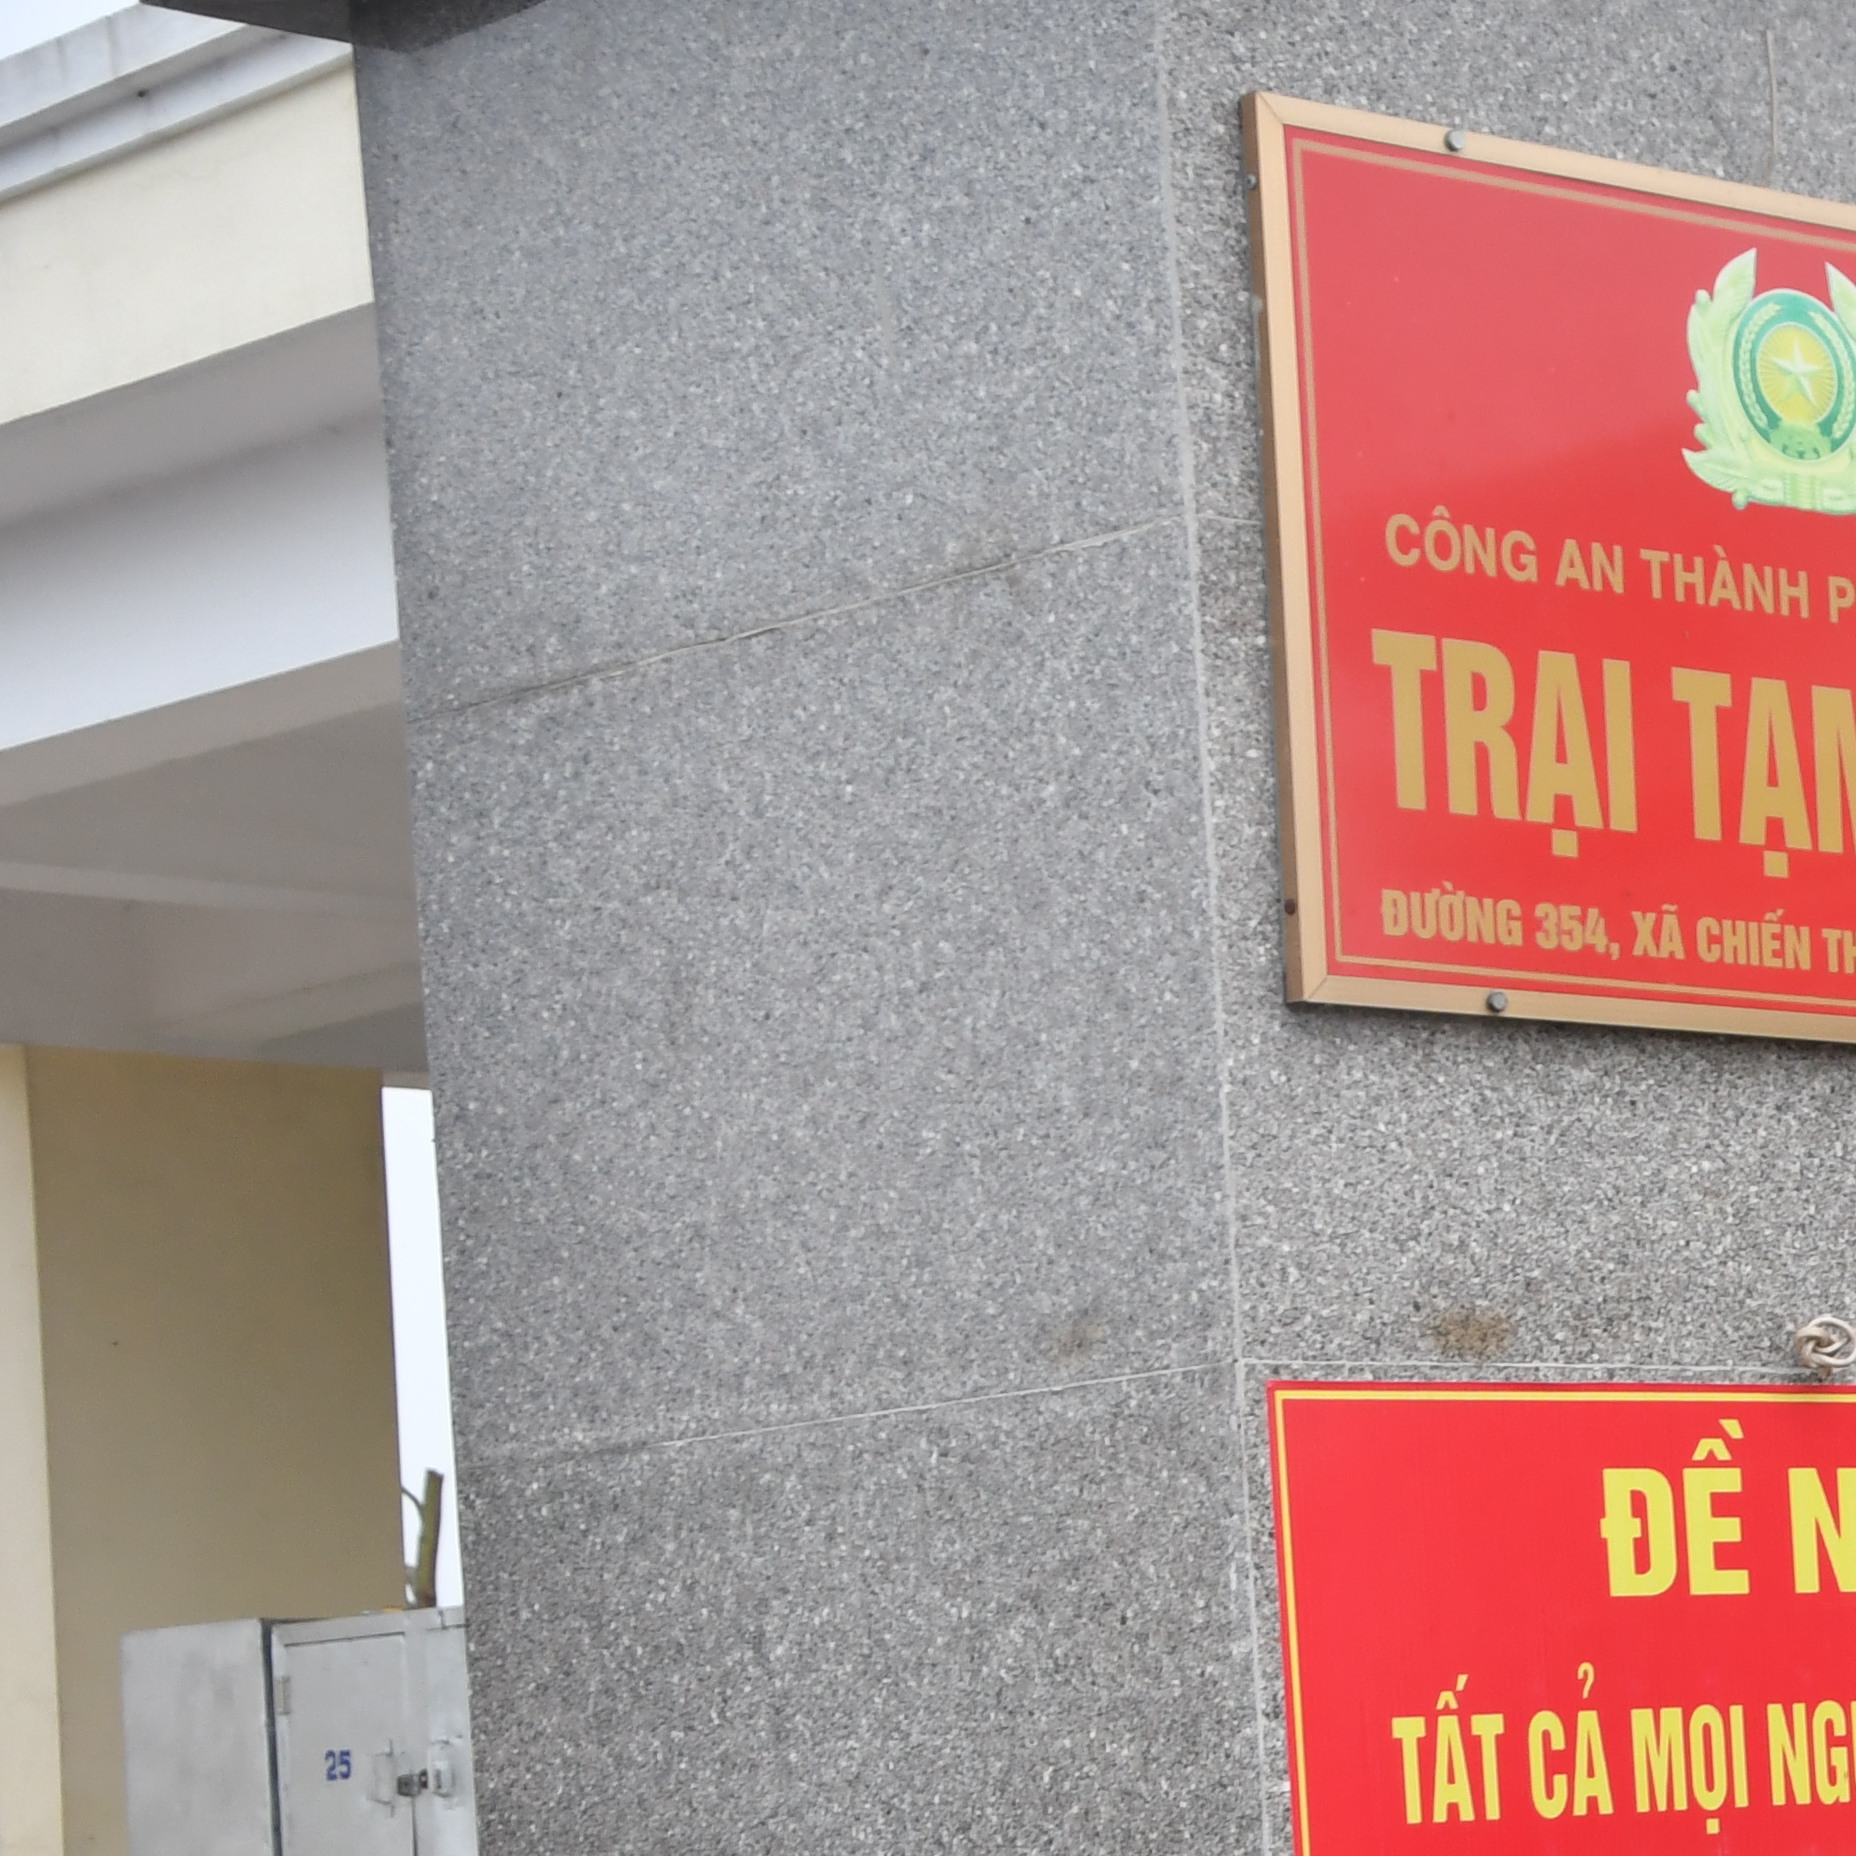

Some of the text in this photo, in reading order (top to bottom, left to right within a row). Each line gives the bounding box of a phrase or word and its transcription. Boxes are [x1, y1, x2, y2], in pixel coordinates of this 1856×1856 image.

[1385, 505, 1539, 583] CÔNG
[1556, 538, 1626, 595] AN
[1640, 545, 1811, 619] THÀNH
[1371, 628, 1639, 859] TRẠI
[1380, 882, 1524, 949] ĐƯỜNG
[1535, 901, 1621, 961] 354,
[1631, 903, 1687, 962] XÃ
[1695, 908, 1813, 973] CHIẾN
[1599, 1417, 1751, 1598] ĐỀ
[325, 1748, 353, 1783] 25
[1390, 1673, 1506, 1826] TẤT
[1527, 1661, 1615, 1821] CẢ
[1629, 1702, 1750, 1836] MỌI
